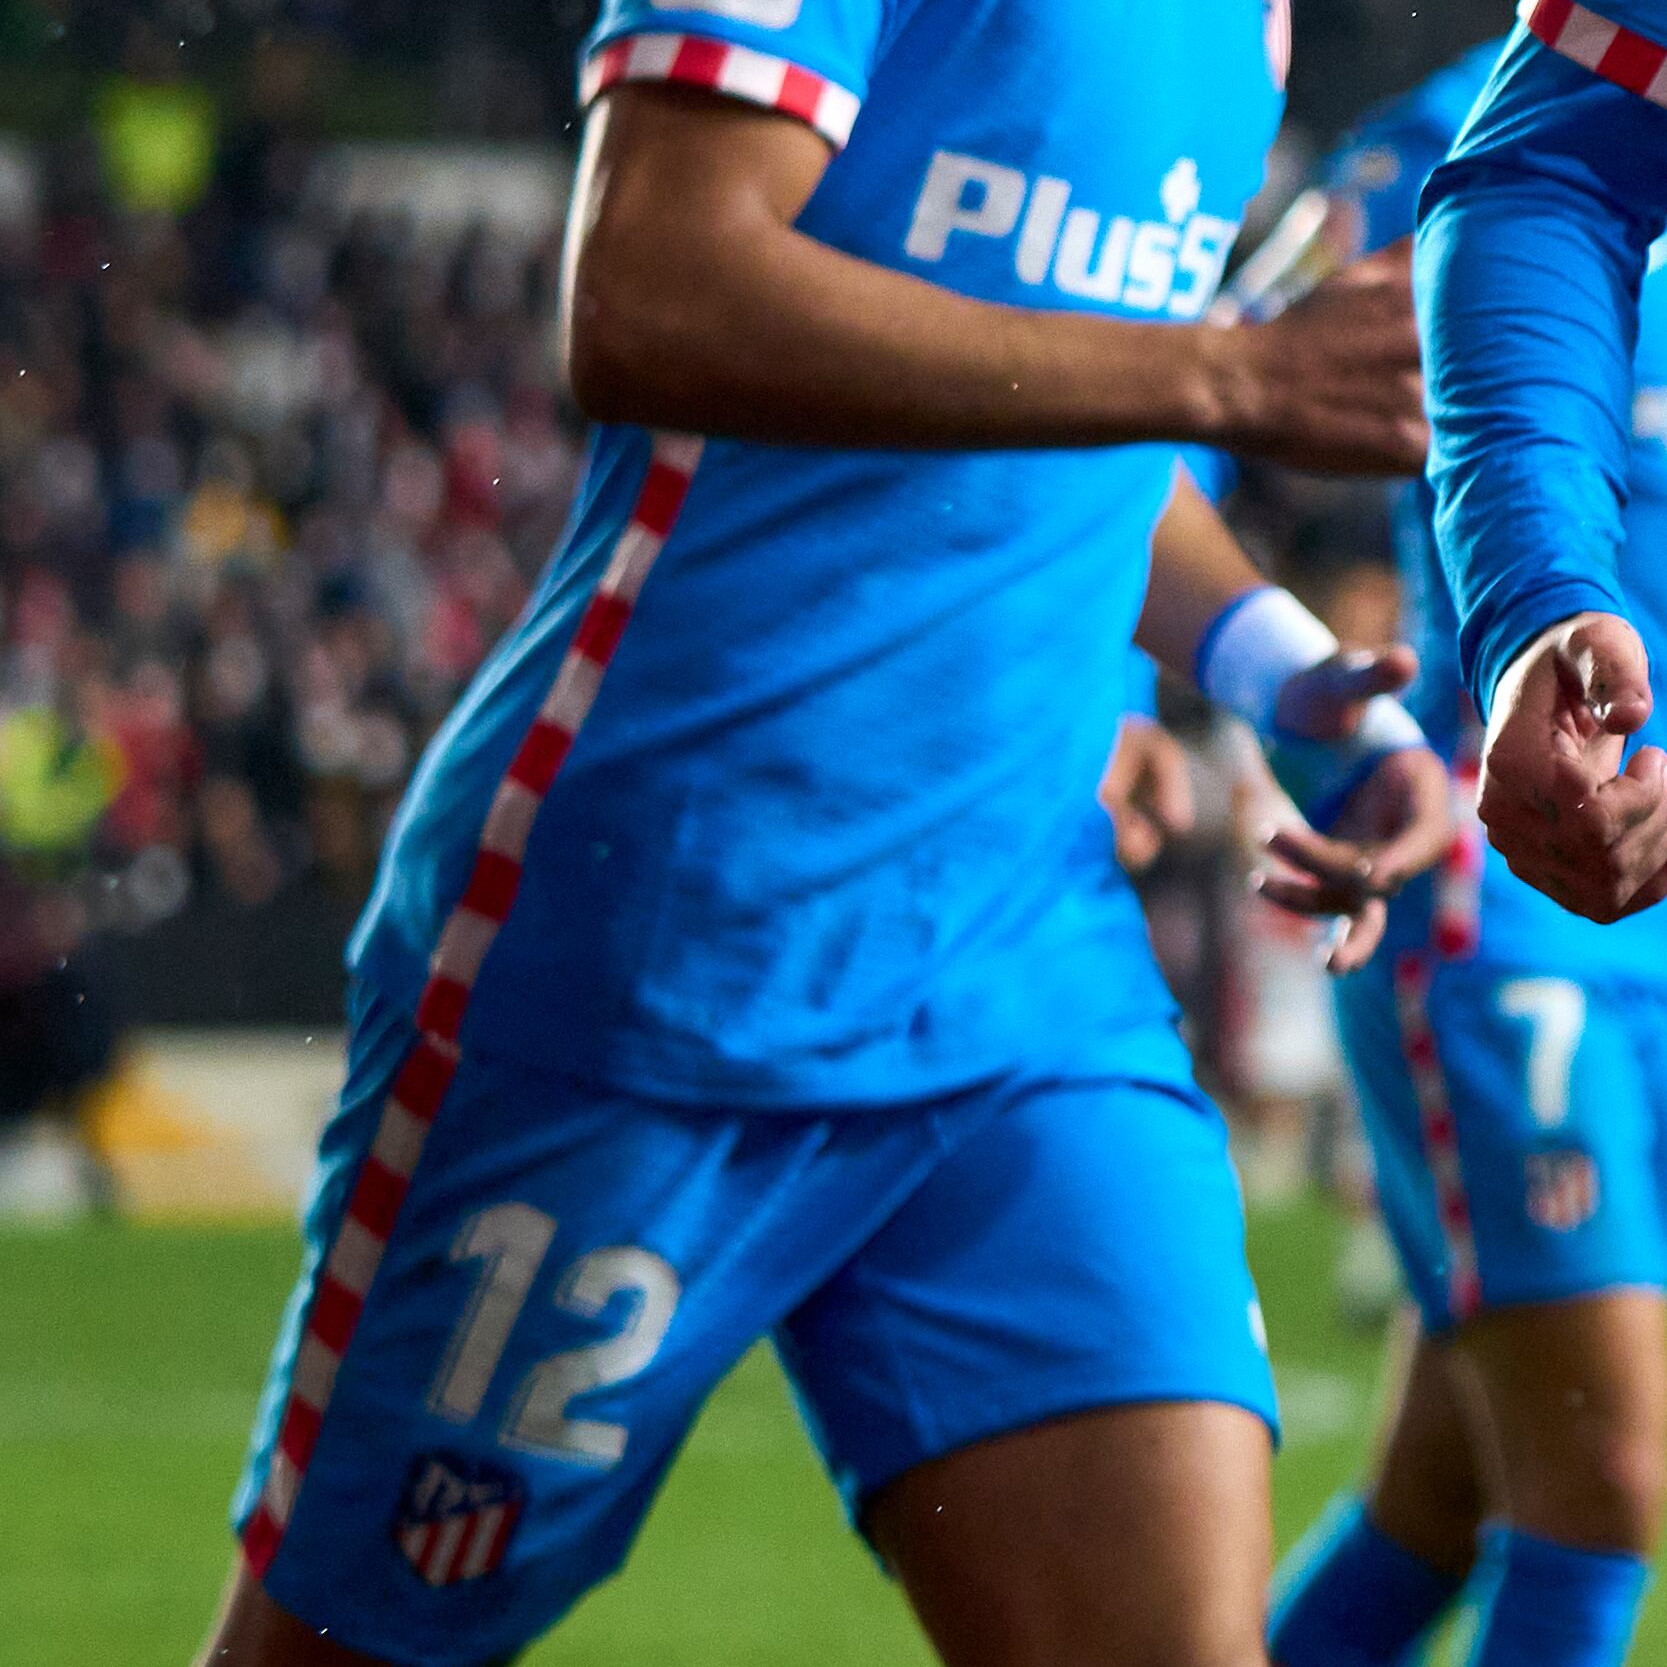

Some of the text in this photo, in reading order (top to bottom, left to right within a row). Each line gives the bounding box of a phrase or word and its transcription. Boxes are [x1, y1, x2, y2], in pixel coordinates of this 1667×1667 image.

[905, 149, 1240, 320] Plus5
[1500, 975, 1587, 1129] 7
[426, 1201, 683, 1471] 12
